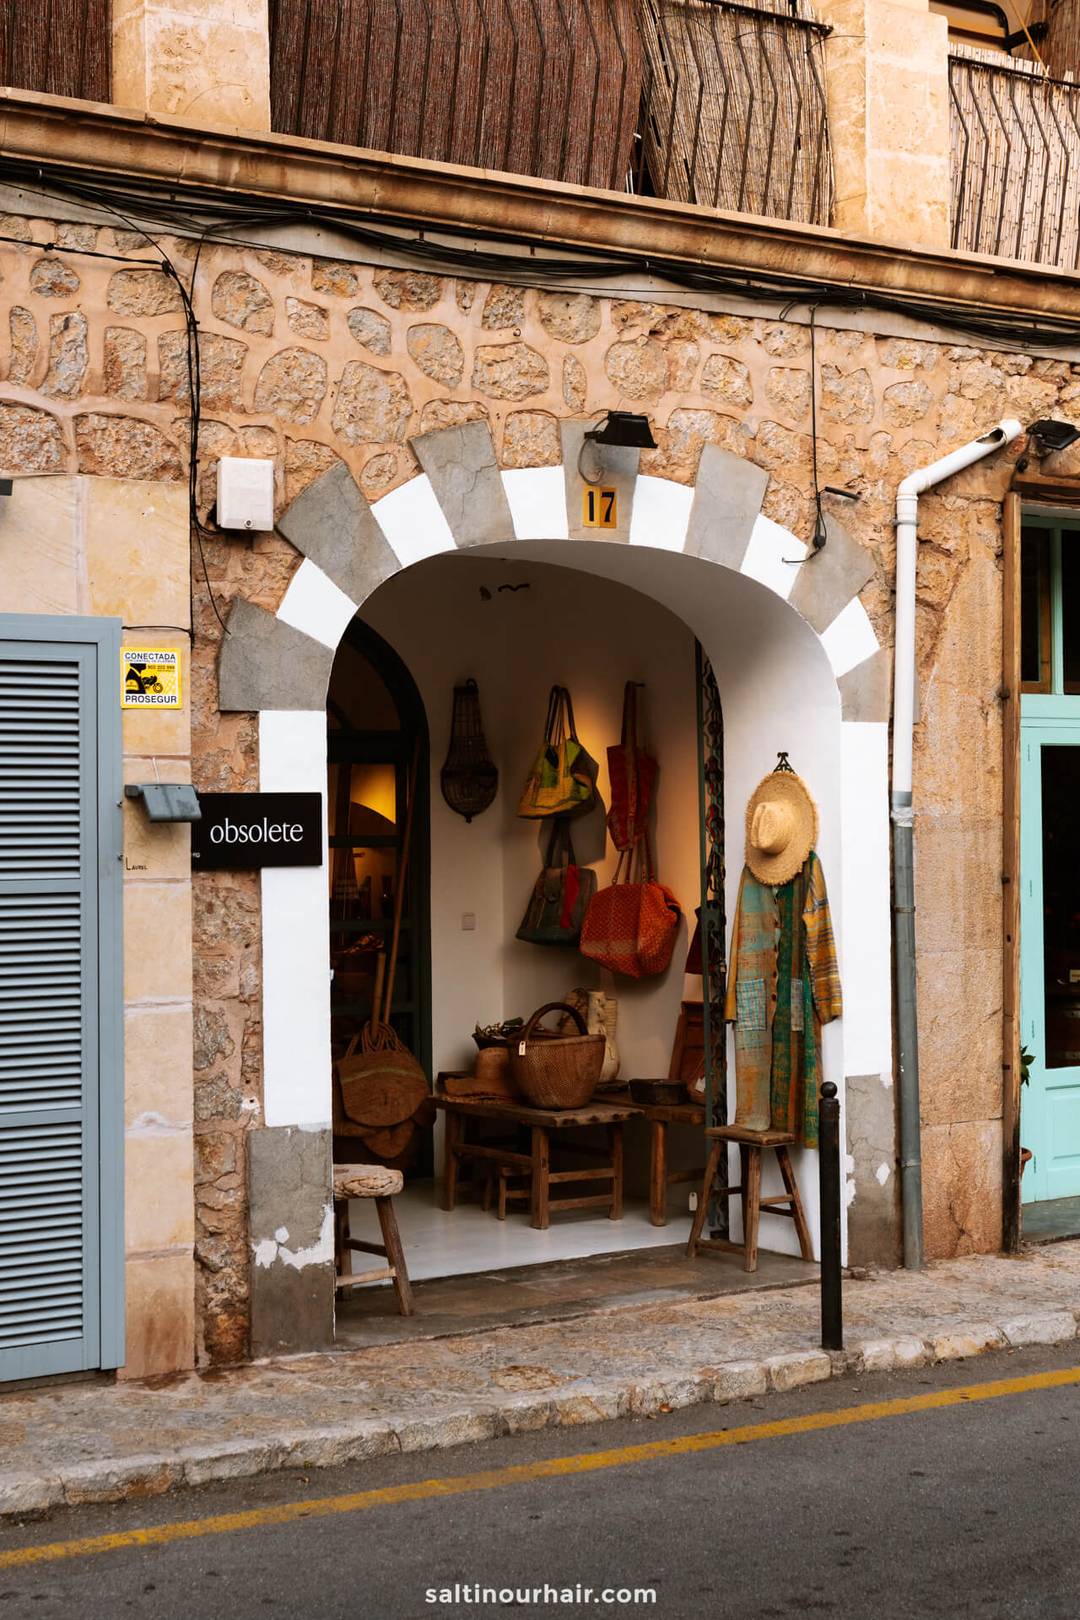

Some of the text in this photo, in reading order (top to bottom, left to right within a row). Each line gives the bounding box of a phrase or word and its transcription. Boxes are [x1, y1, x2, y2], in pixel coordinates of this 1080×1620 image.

[588, 491, 615, 522] 17
[125, 652, 176, 660] CONECTADA
[125, 695, 177, 703] PROSEGUR
[210, 817, 304, 843] obsolete
